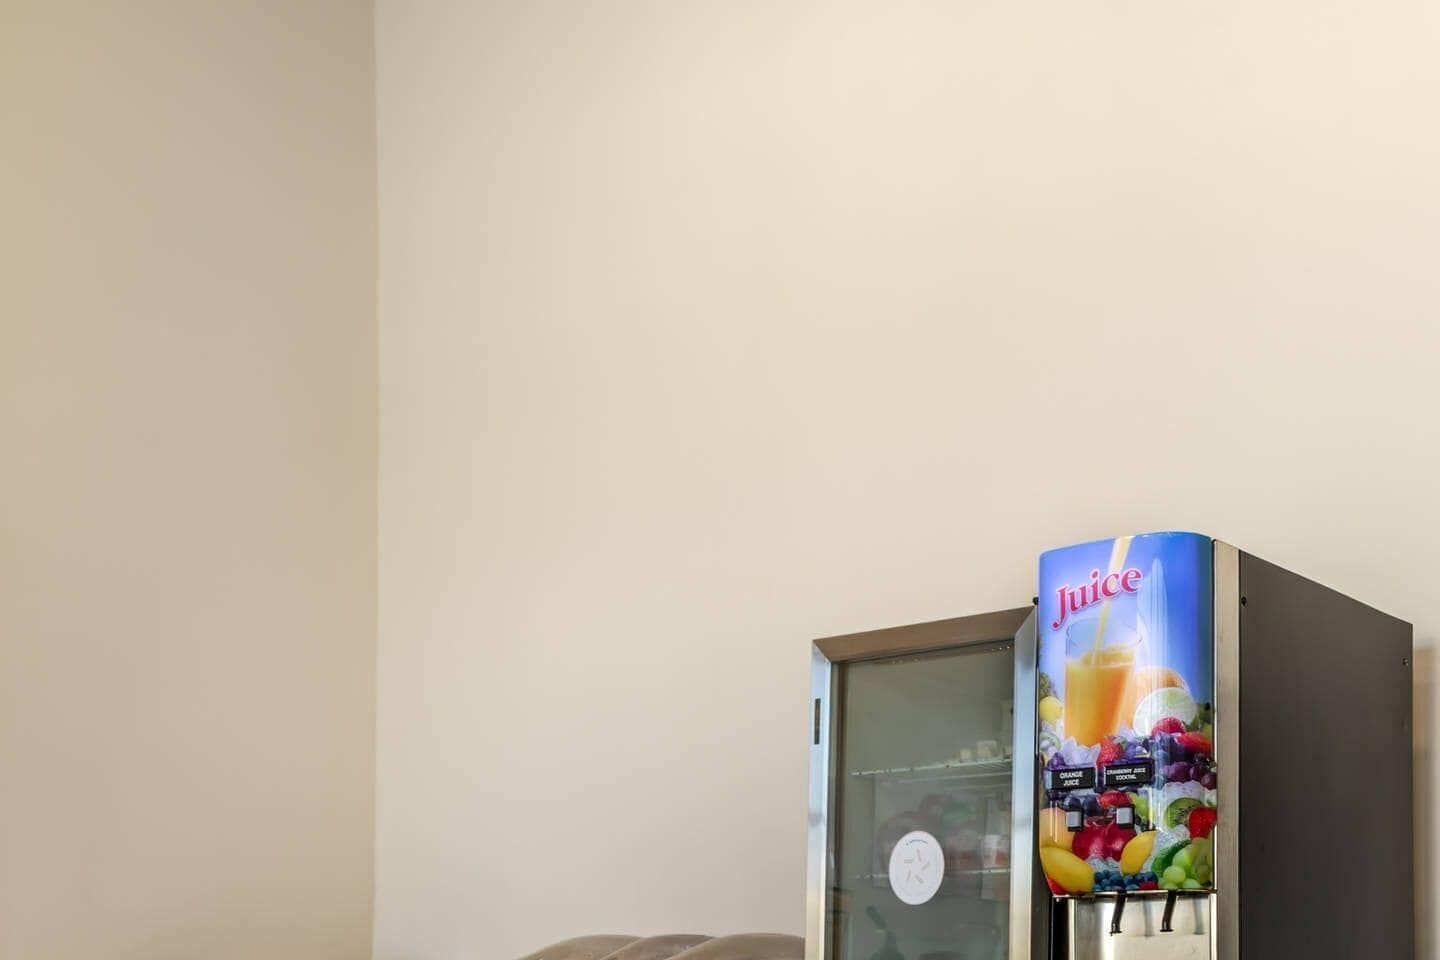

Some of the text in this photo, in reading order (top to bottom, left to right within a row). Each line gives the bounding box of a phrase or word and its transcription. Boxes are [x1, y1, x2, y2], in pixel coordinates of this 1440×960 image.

[1051, 567, 1143, 630] Juice
[1059, 770, 1083, 779] ORANGE
[1063, 779, 1080, 787] JUICE
